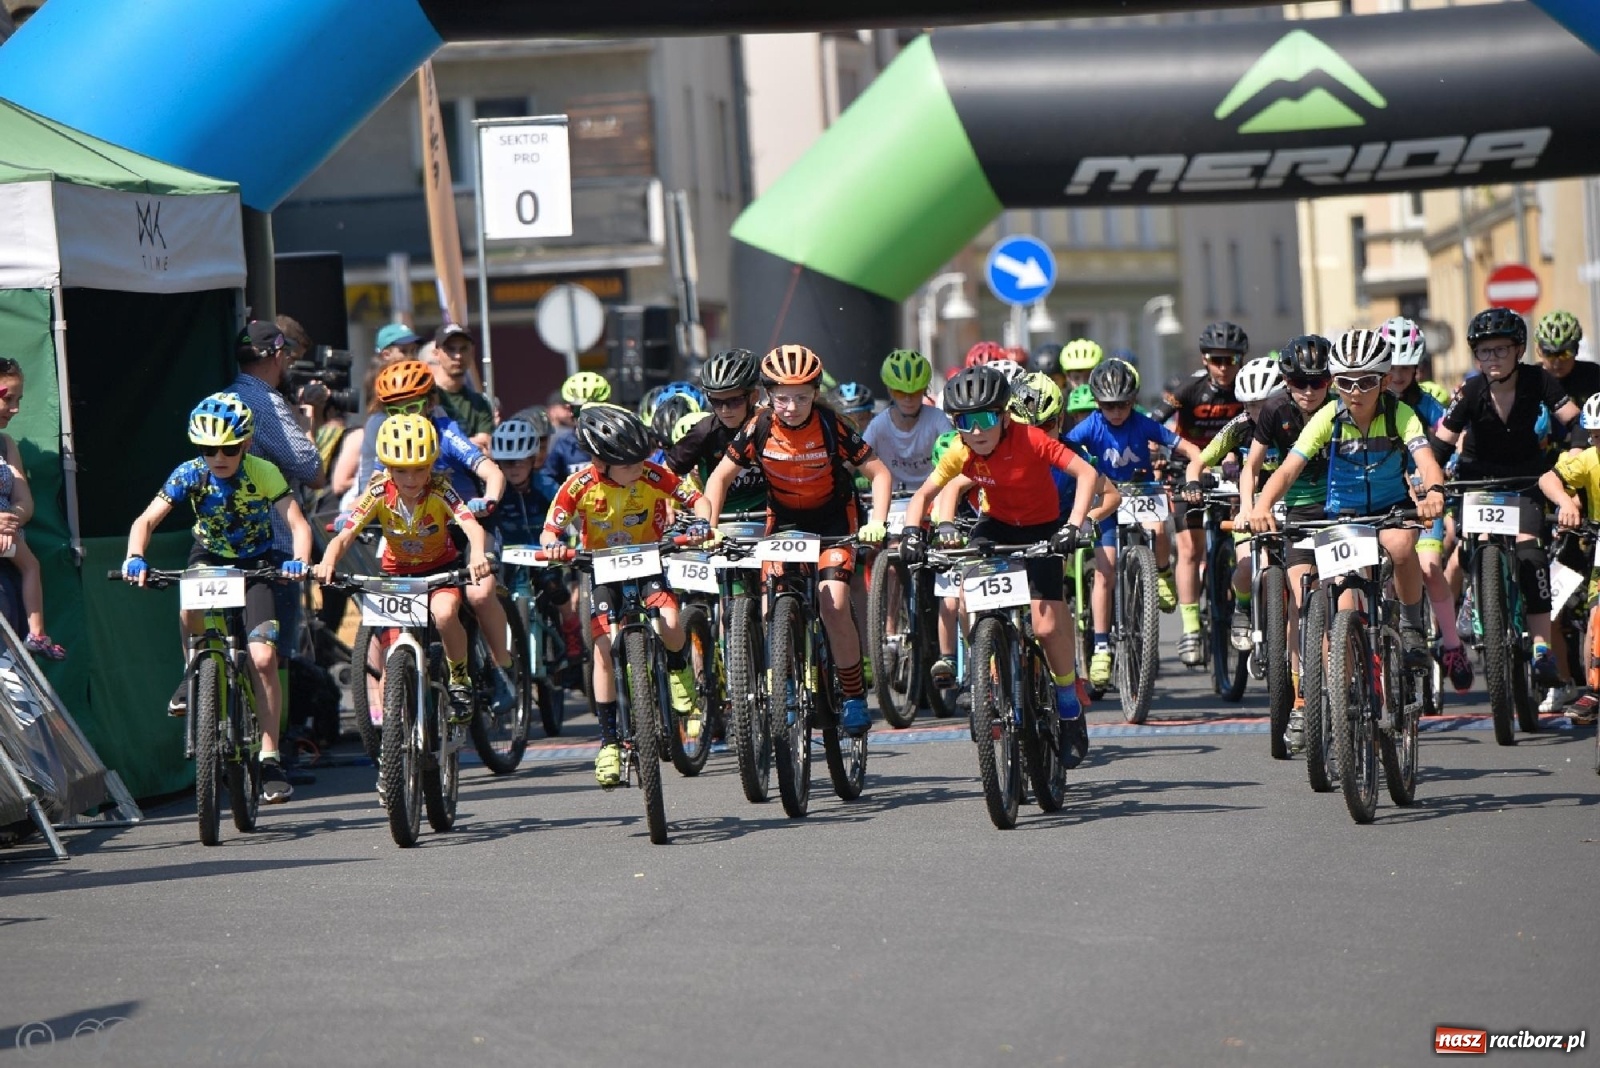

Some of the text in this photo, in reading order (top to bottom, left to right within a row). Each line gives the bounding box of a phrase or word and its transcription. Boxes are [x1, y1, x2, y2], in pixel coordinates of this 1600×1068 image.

[499, 133, 549, 146] SEKTOR
[513, 152, 540, 164] PRO
[1064, 127, 1553, 195] MERIDA
[516, 190, 540, 225] 0
[1131, 498, 1156, 513] 128
[1478, 508, 1506, 523] 132
[770, 540, 808, 552] 200
[609, 554, 644, 569] 155
[681, 564, 709, 580] 158
[196, 580, 228, 597] 142
[980, 576, 1013, 597] 153
[379, 596, 412, 614] 108
